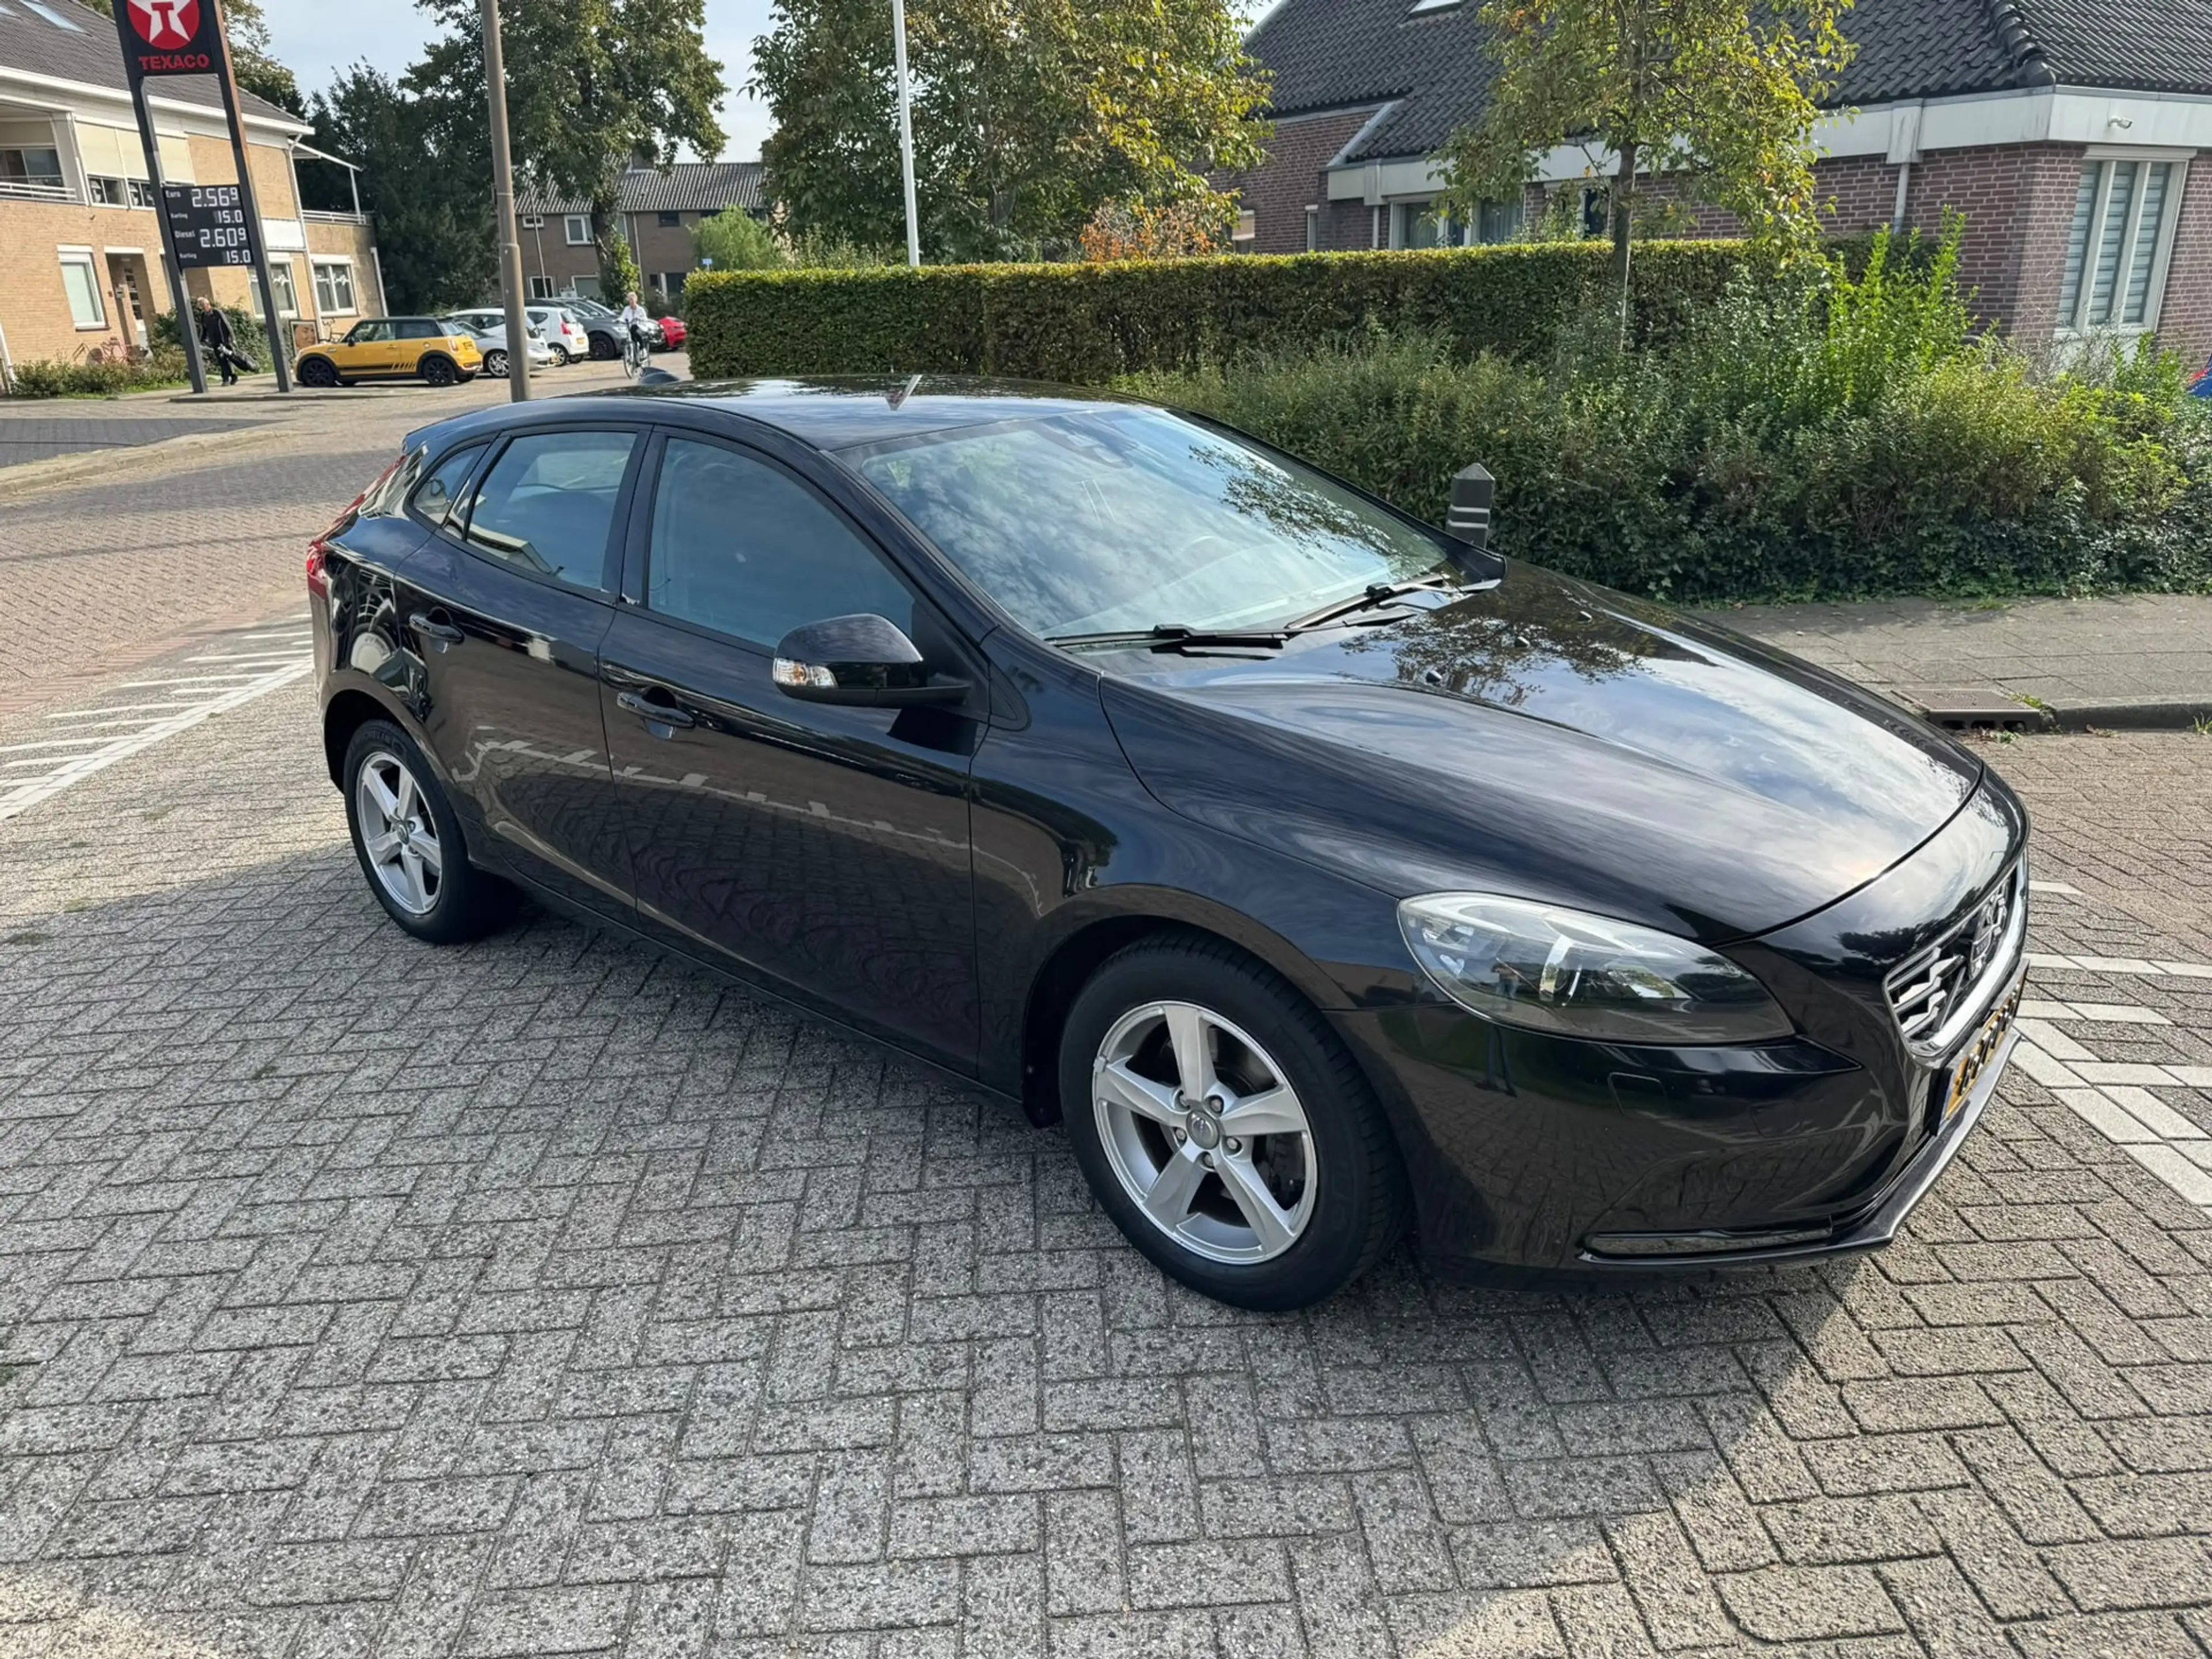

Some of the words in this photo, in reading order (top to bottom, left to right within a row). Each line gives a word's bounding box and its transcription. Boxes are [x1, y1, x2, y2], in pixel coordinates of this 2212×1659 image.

[138, 54, 210, 70] TEXACO
[191, 187, 239, 207] 2.569
[218, 210, 243, 224] 15.0
[175, 230, 195, 238] Diesel
[200, 228, 247, 247] 2.609
[226, 249, 251, 263] 15.0
